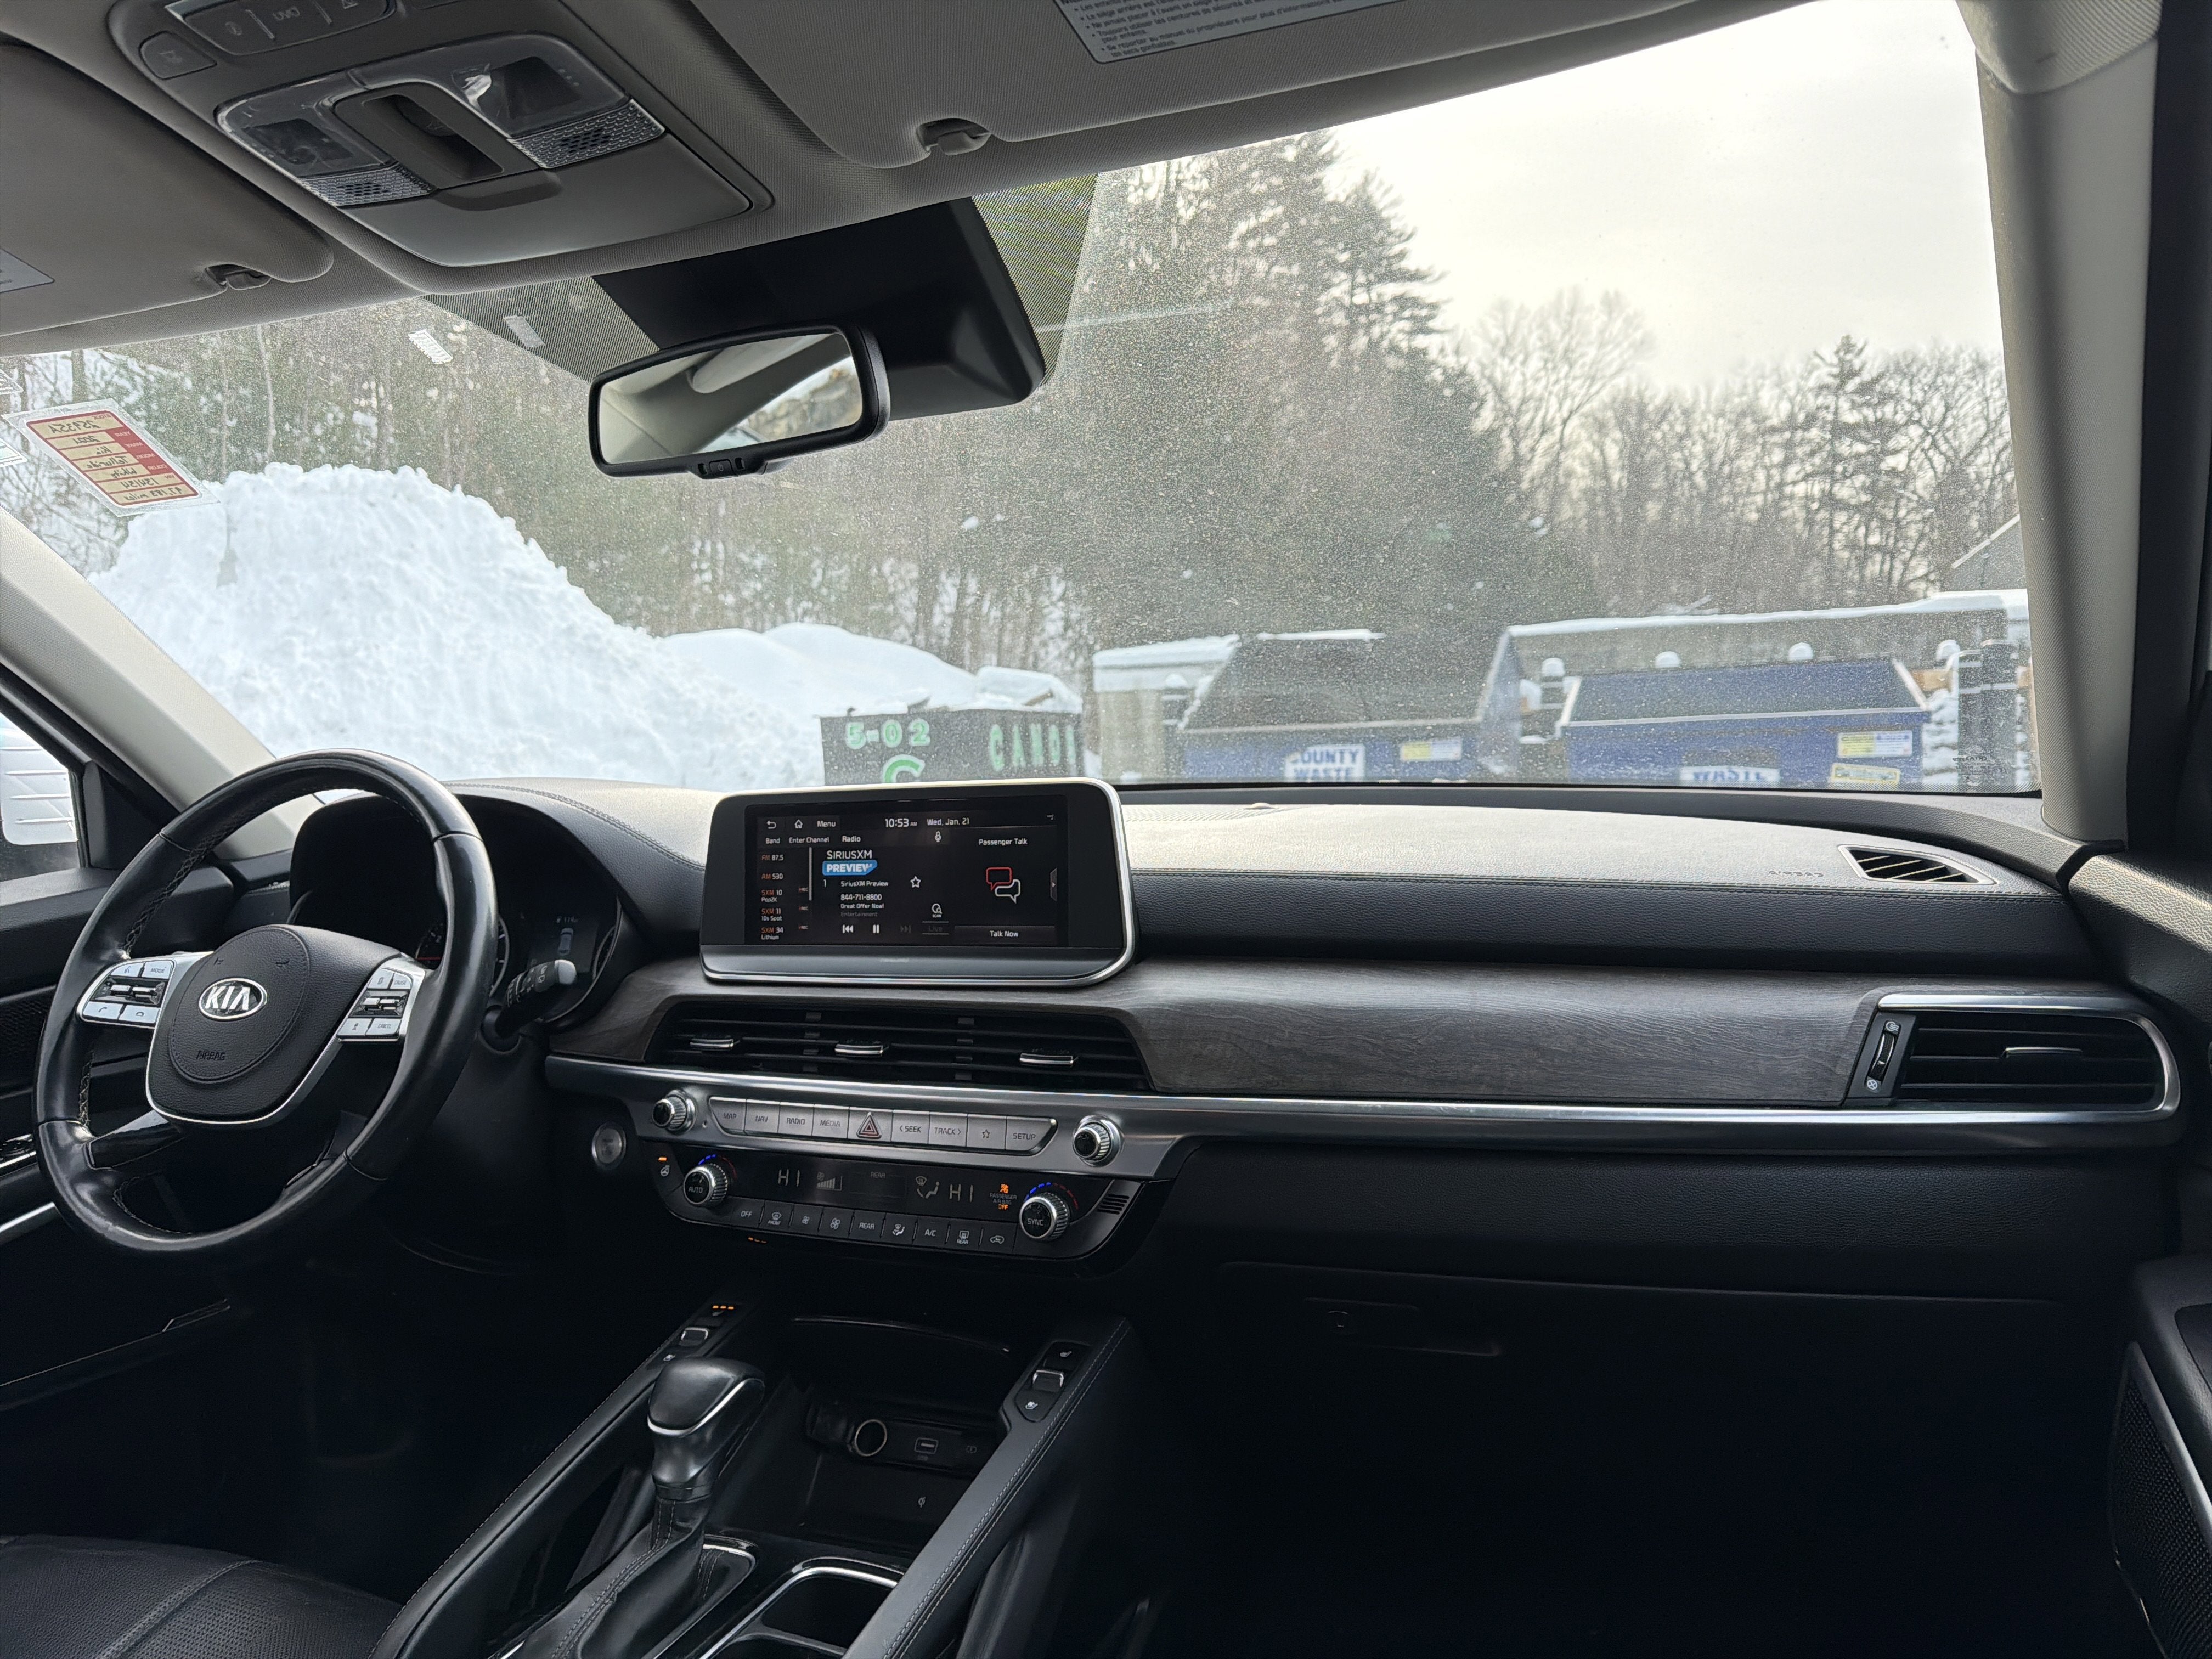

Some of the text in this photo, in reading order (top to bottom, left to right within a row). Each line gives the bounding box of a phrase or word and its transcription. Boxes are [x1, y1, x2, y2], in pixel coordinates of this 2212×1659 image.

[884, 818, 909, 828] 10:53
[826, 863, 873, 873] PREVIEW
[205, 986, 251, 1011] KIA
[196, 1050, 225, 1061] AIRBAG
[934, 1127, 956, 1135] TRACK
[1013, 1132, 1036, 1141] SETUP
[1027, 1218, 1045, 1226] SYNC
